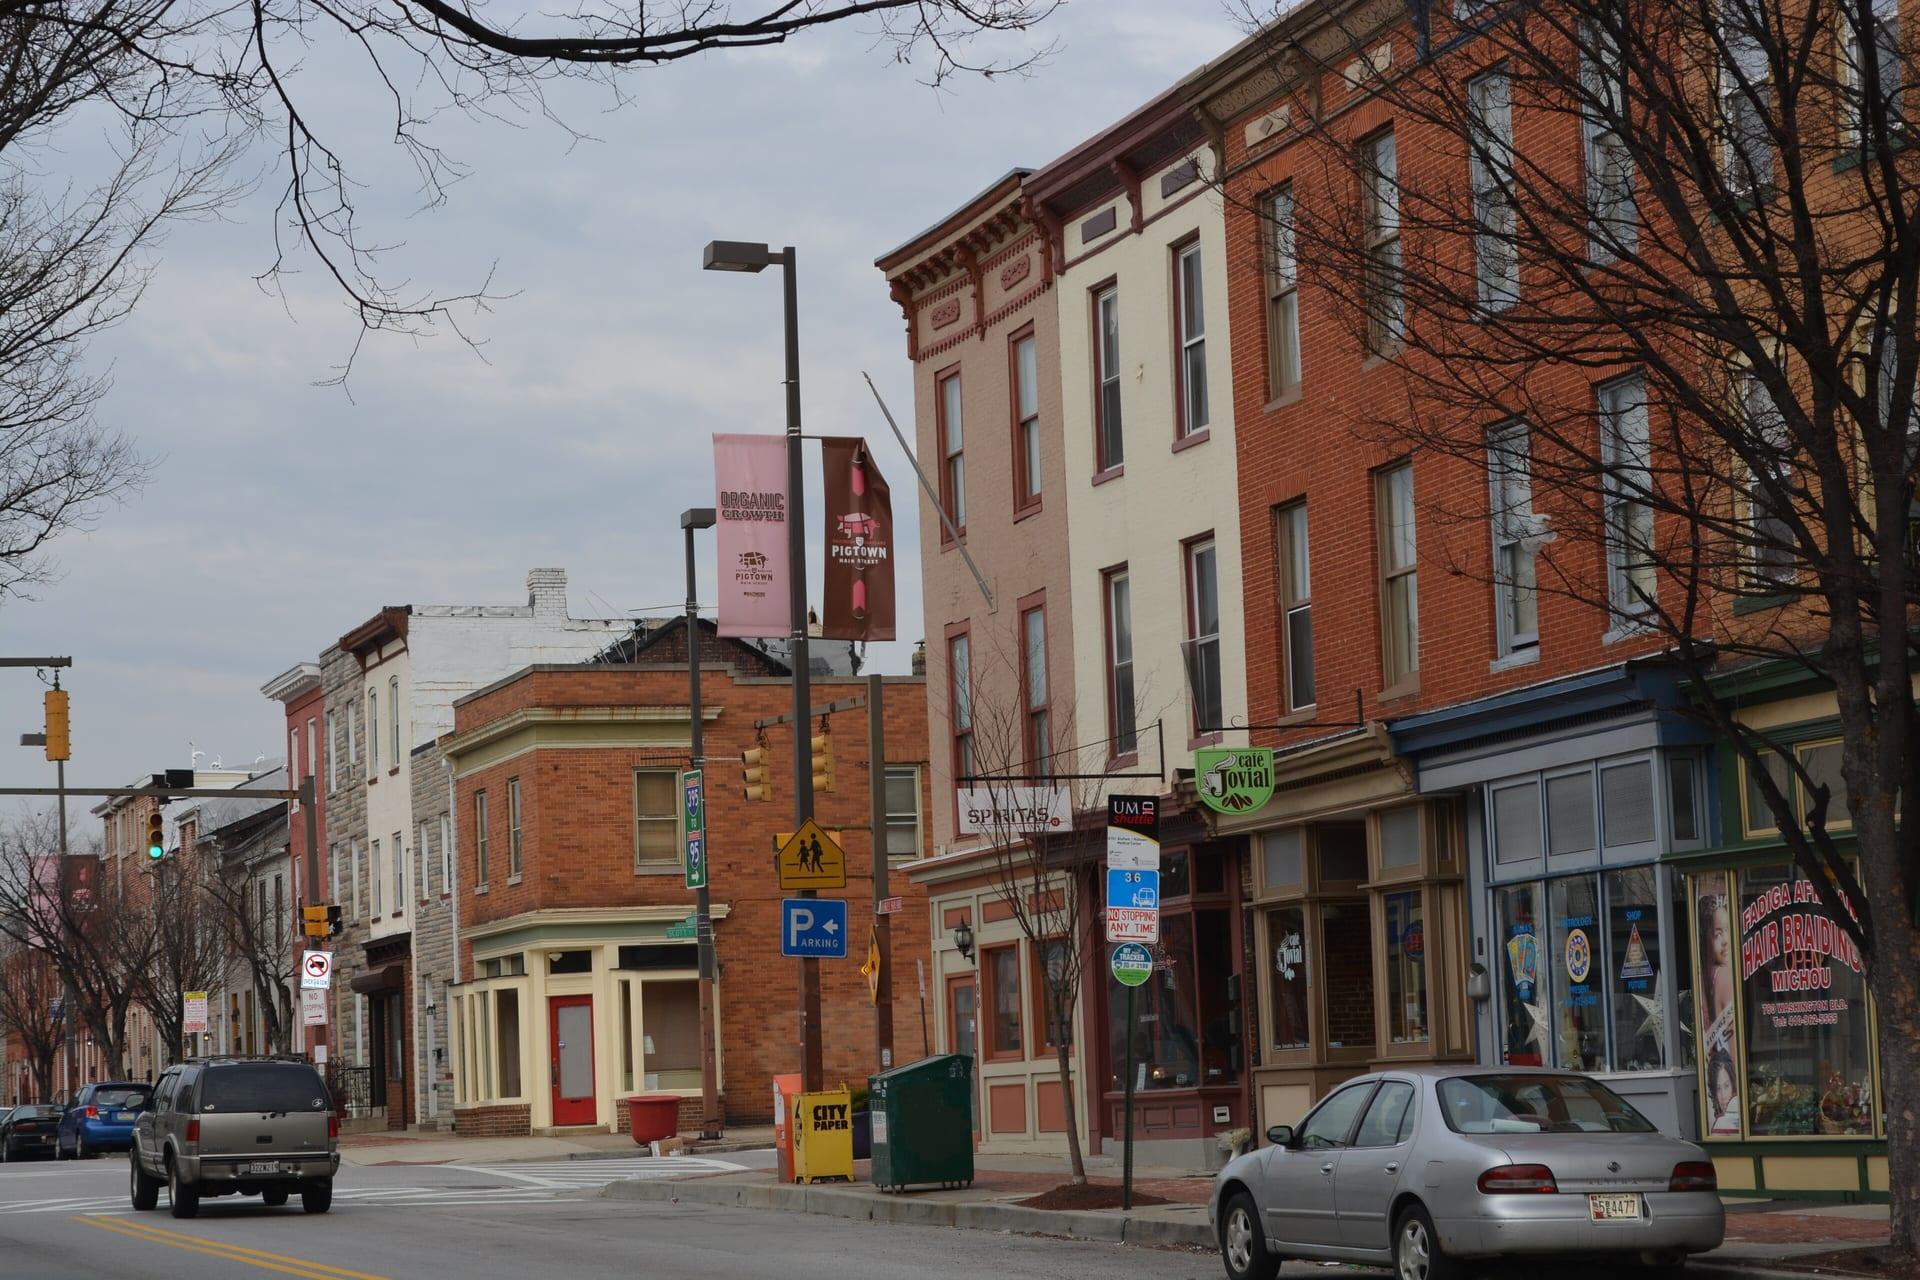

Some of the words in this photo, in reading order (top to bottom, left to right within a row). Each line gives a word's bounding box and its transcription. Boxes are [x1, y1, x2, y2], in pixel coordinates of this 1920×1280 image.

[721, 491, 784, 510] ORGANIC
[722, 510, 784, 522] GROWTH
[832, 545, 887, 560] PIGTOWN
[735, 573, 773, 582] PIGTOWN
[1238, 753, 1265, 768] café
[1210, 768, 1270, 798] Jovial
[687, 788, 698, 807] 395
[1114, 801, 1139, 815] UM
[1113, 813, 1154, 825] shuttle
[689, 841, 699, 864] 95
[1625, 910, 1642, 921] SHOP
[1743, 882, 1792, 935] FADIGA
[1108, 910, 1119, 921] NO
[1121, 911, 1156, 922] STOPPING
[1110, 923, 1130, 933] ANY
[1134, 923, 1155, 934] TIME
[1119, 953, 1145, 961] TRACKER
[1743, 920, 1780, 981] HAIR
[1771, 967, 1832, 992] MICHOU
[308, 992, 318, 1001] NO
[1776, 1000, 1829, 1014] WASHINGTON
[813, 1104, 848, 1122] CITY
[814, 1119, 849, 1131] PAPER
